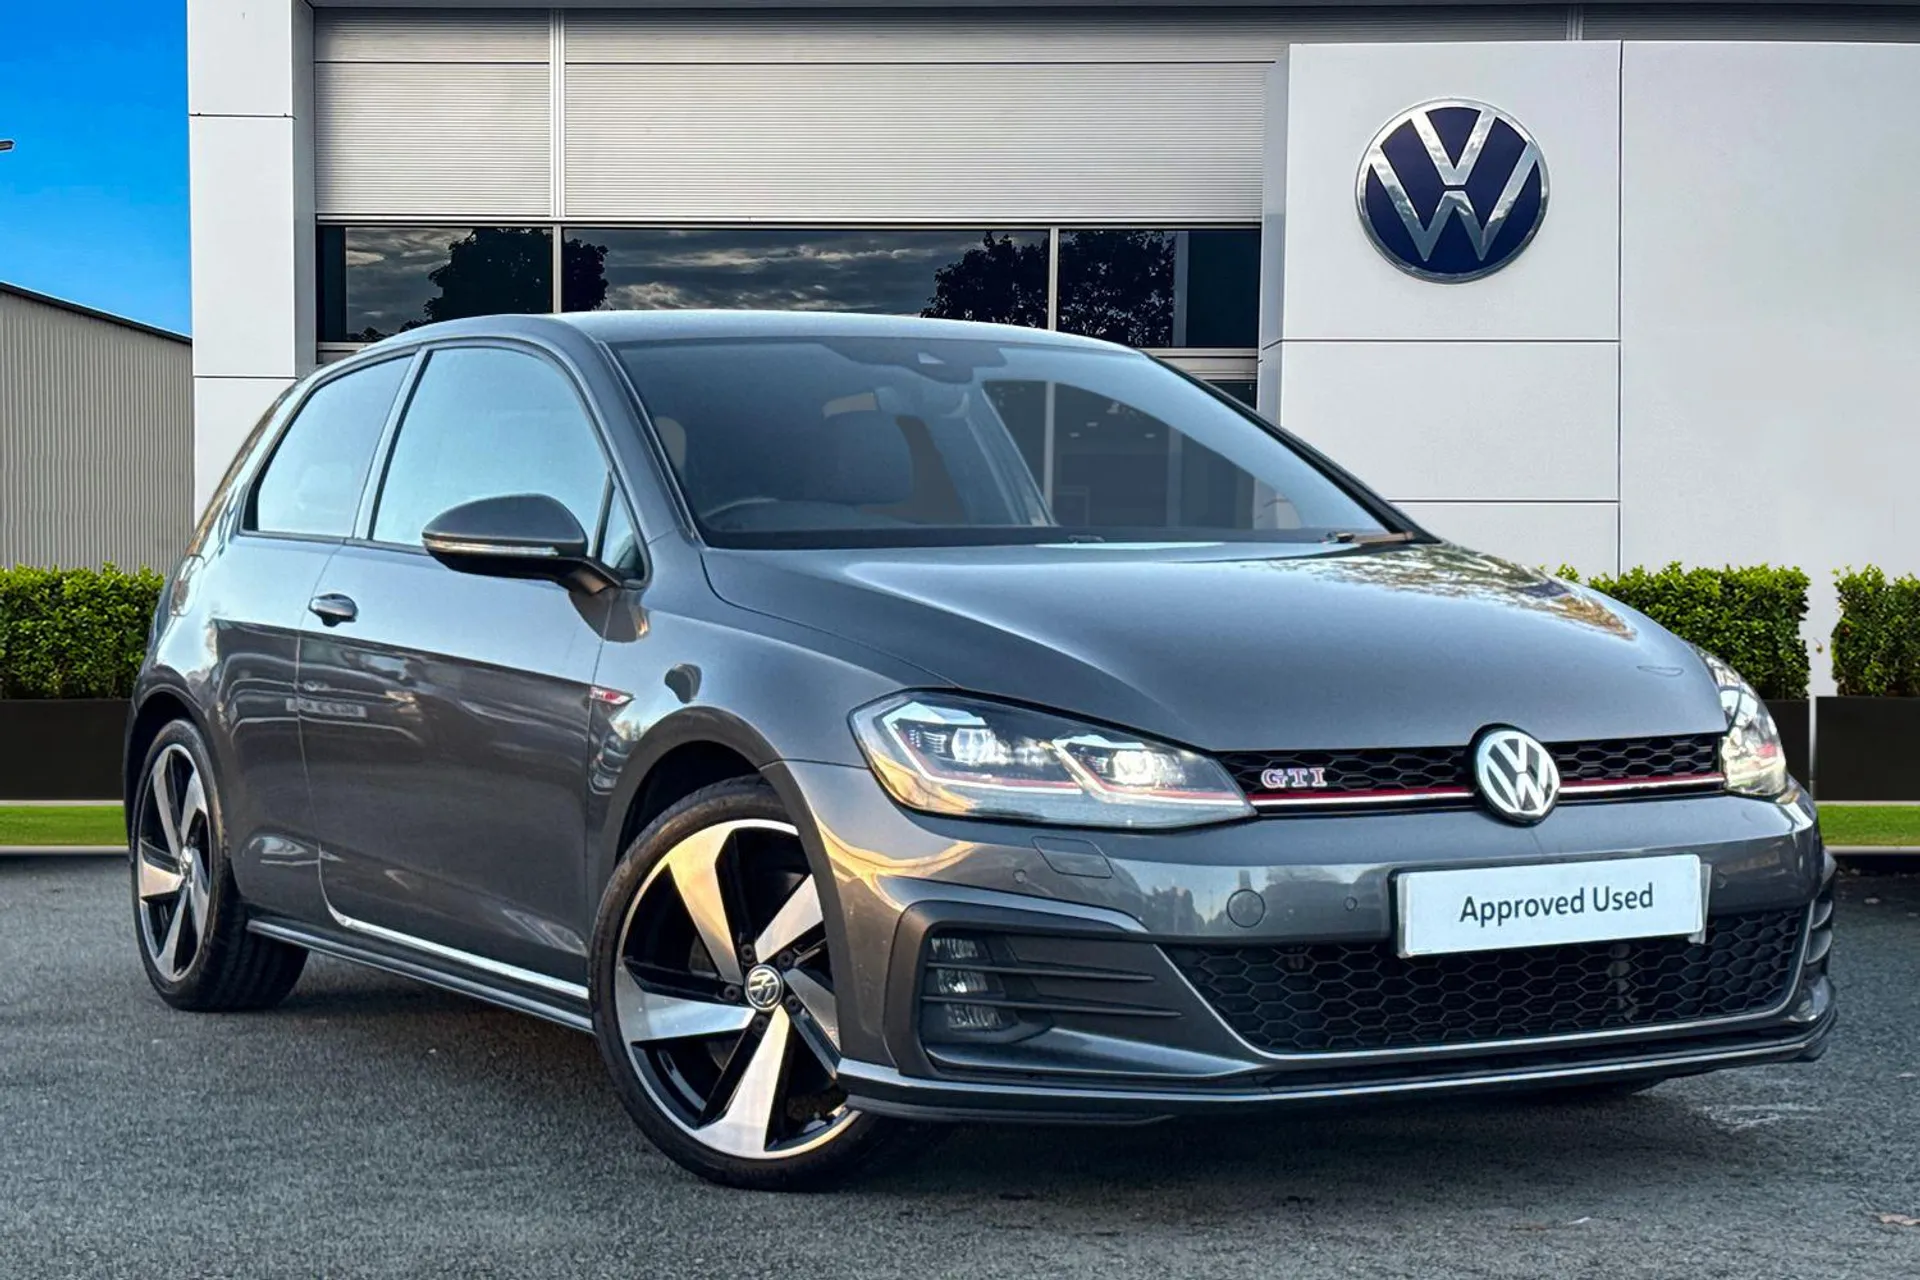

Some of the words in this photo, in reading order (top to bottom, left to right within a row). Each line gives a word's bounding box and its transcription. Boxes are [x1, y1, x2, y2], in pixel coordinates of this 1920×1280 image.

[1261, 768, 1328, 789] GTI
[1459, 886, 1585, 928] Approved
[1593, 881, 1654, 912] Used
